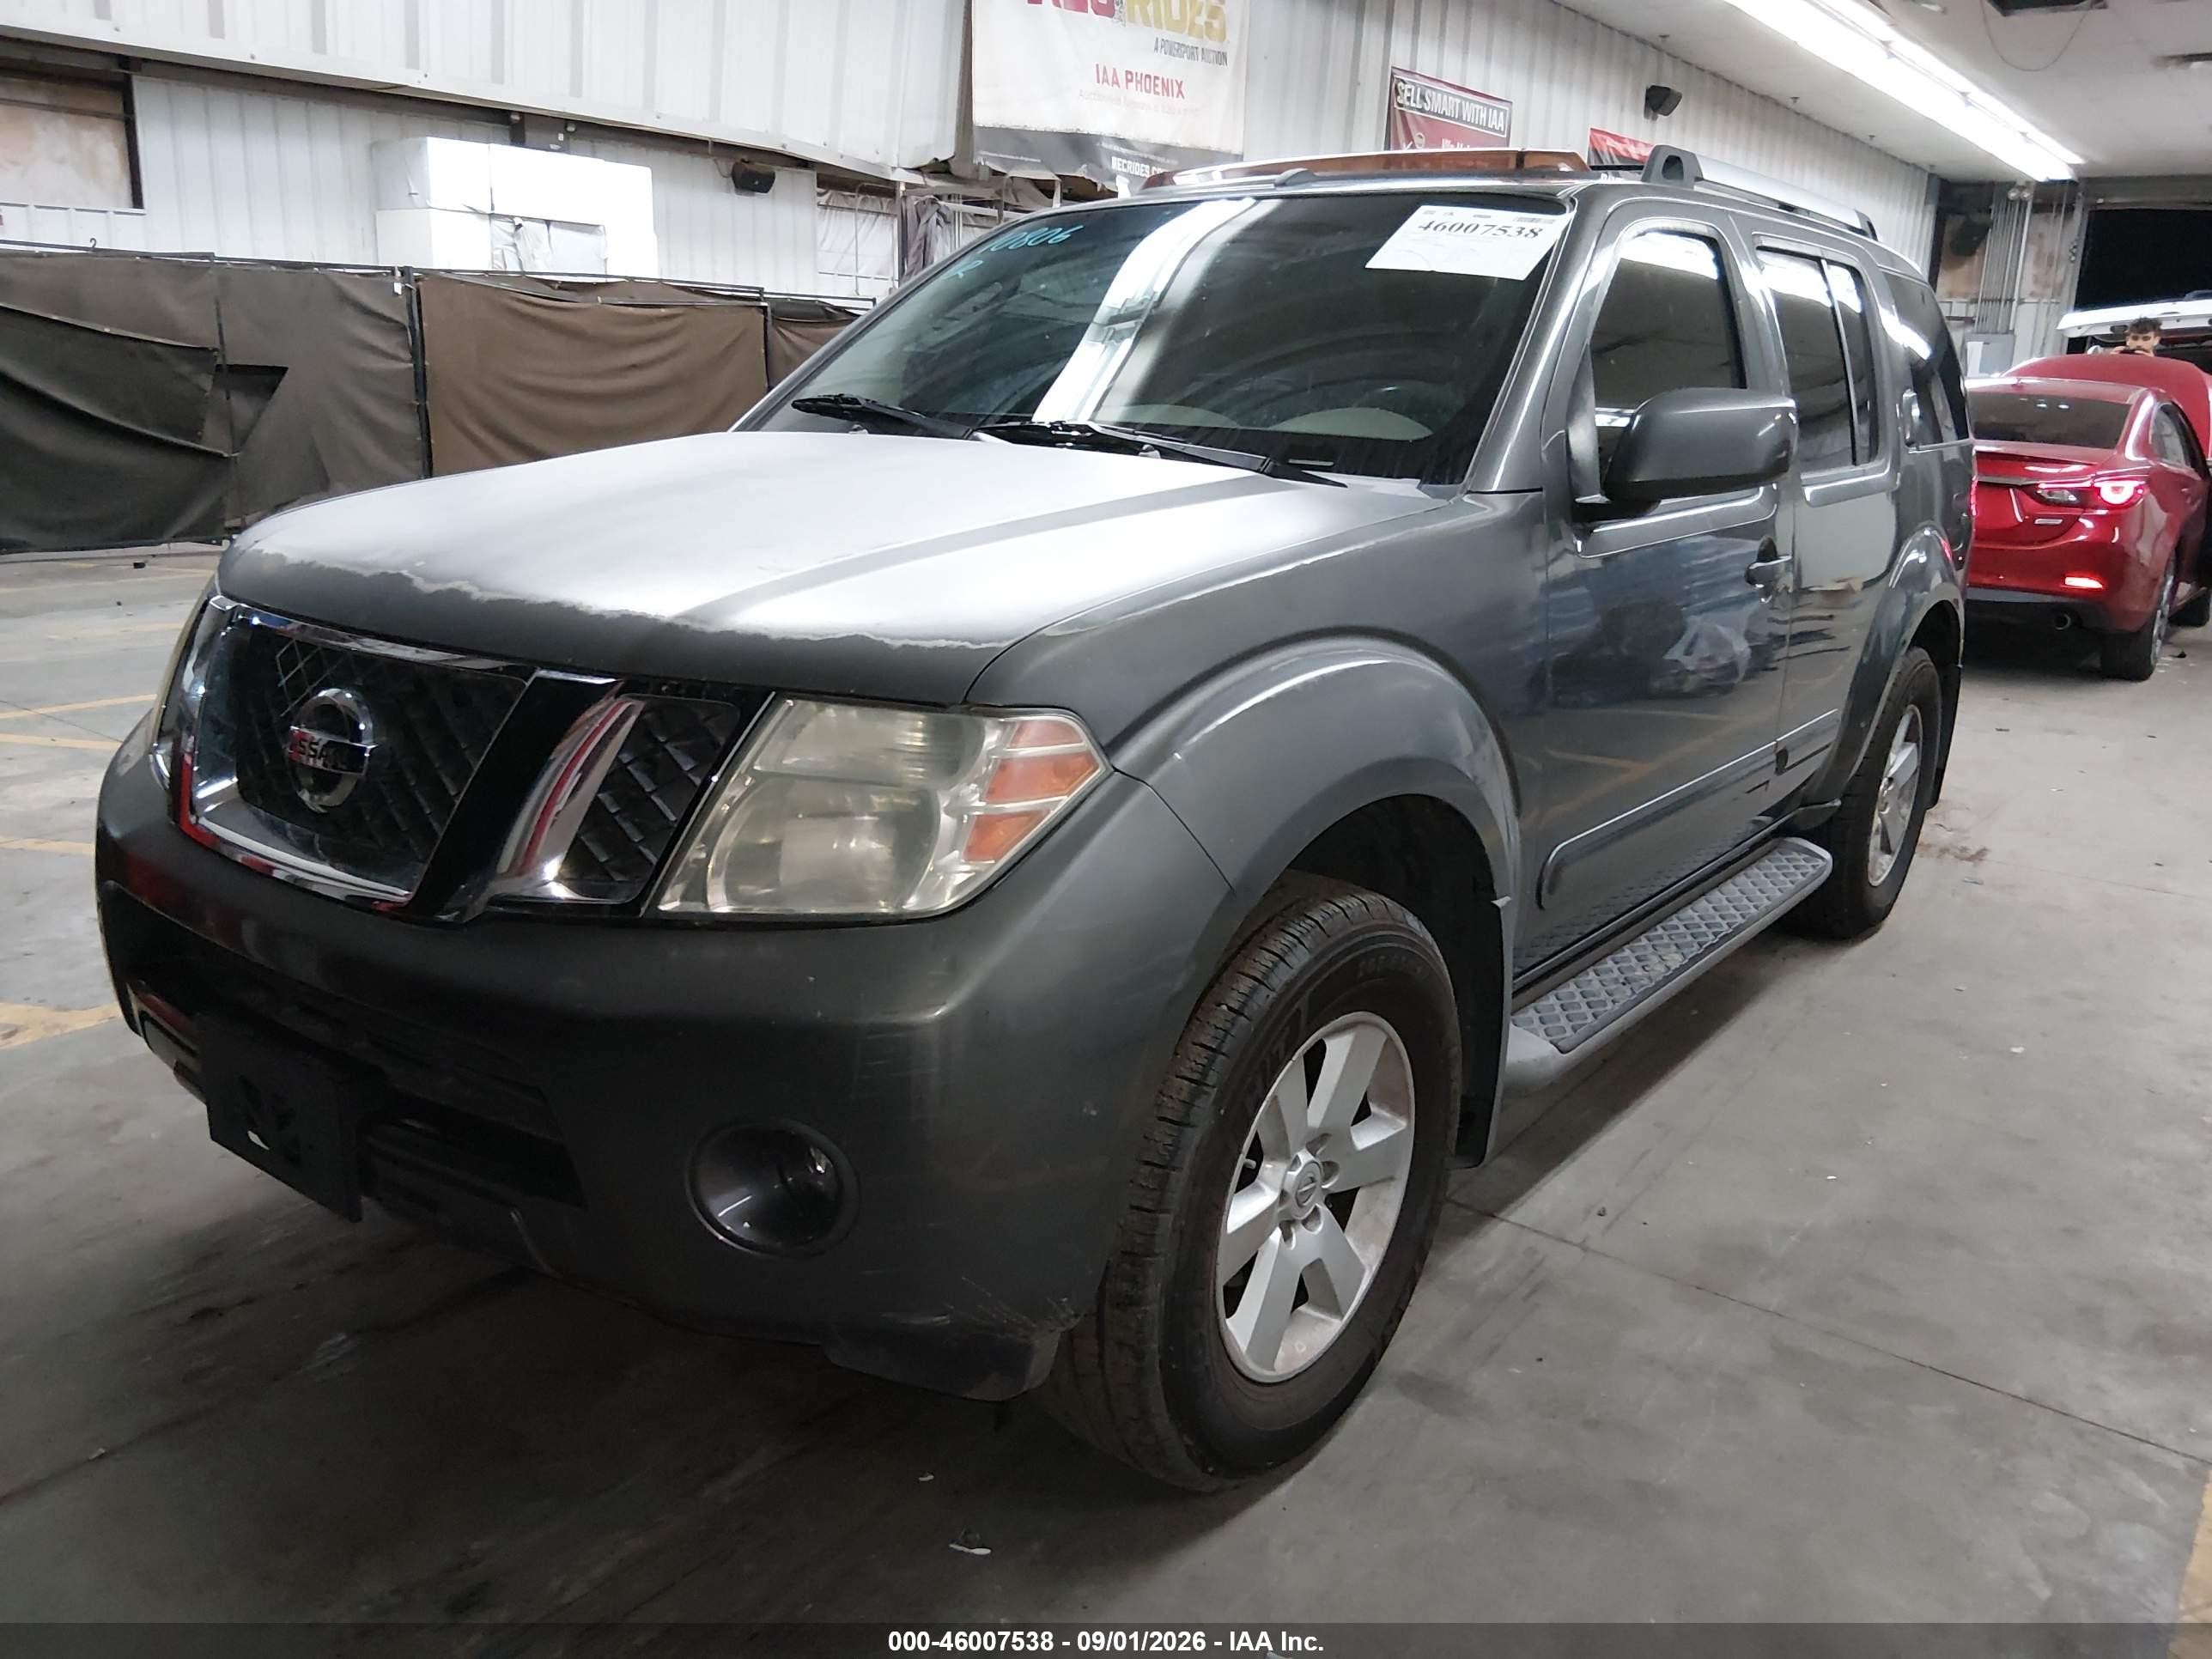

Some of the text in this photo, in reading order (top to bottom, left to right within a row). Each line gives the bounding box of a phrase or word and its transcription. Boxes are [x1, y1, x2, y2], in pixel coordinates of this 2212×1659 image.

[1160, 38, 1199, 63] POWERSPORT
[1201, 47, 1228, 66] AUCTION
[1095, 64, 1185, 100] IAA PHOENIX
[1396, 82, 1504, 132] SELL SMART WITH IAA
[1419, 221, 1544, 240] 46007538
